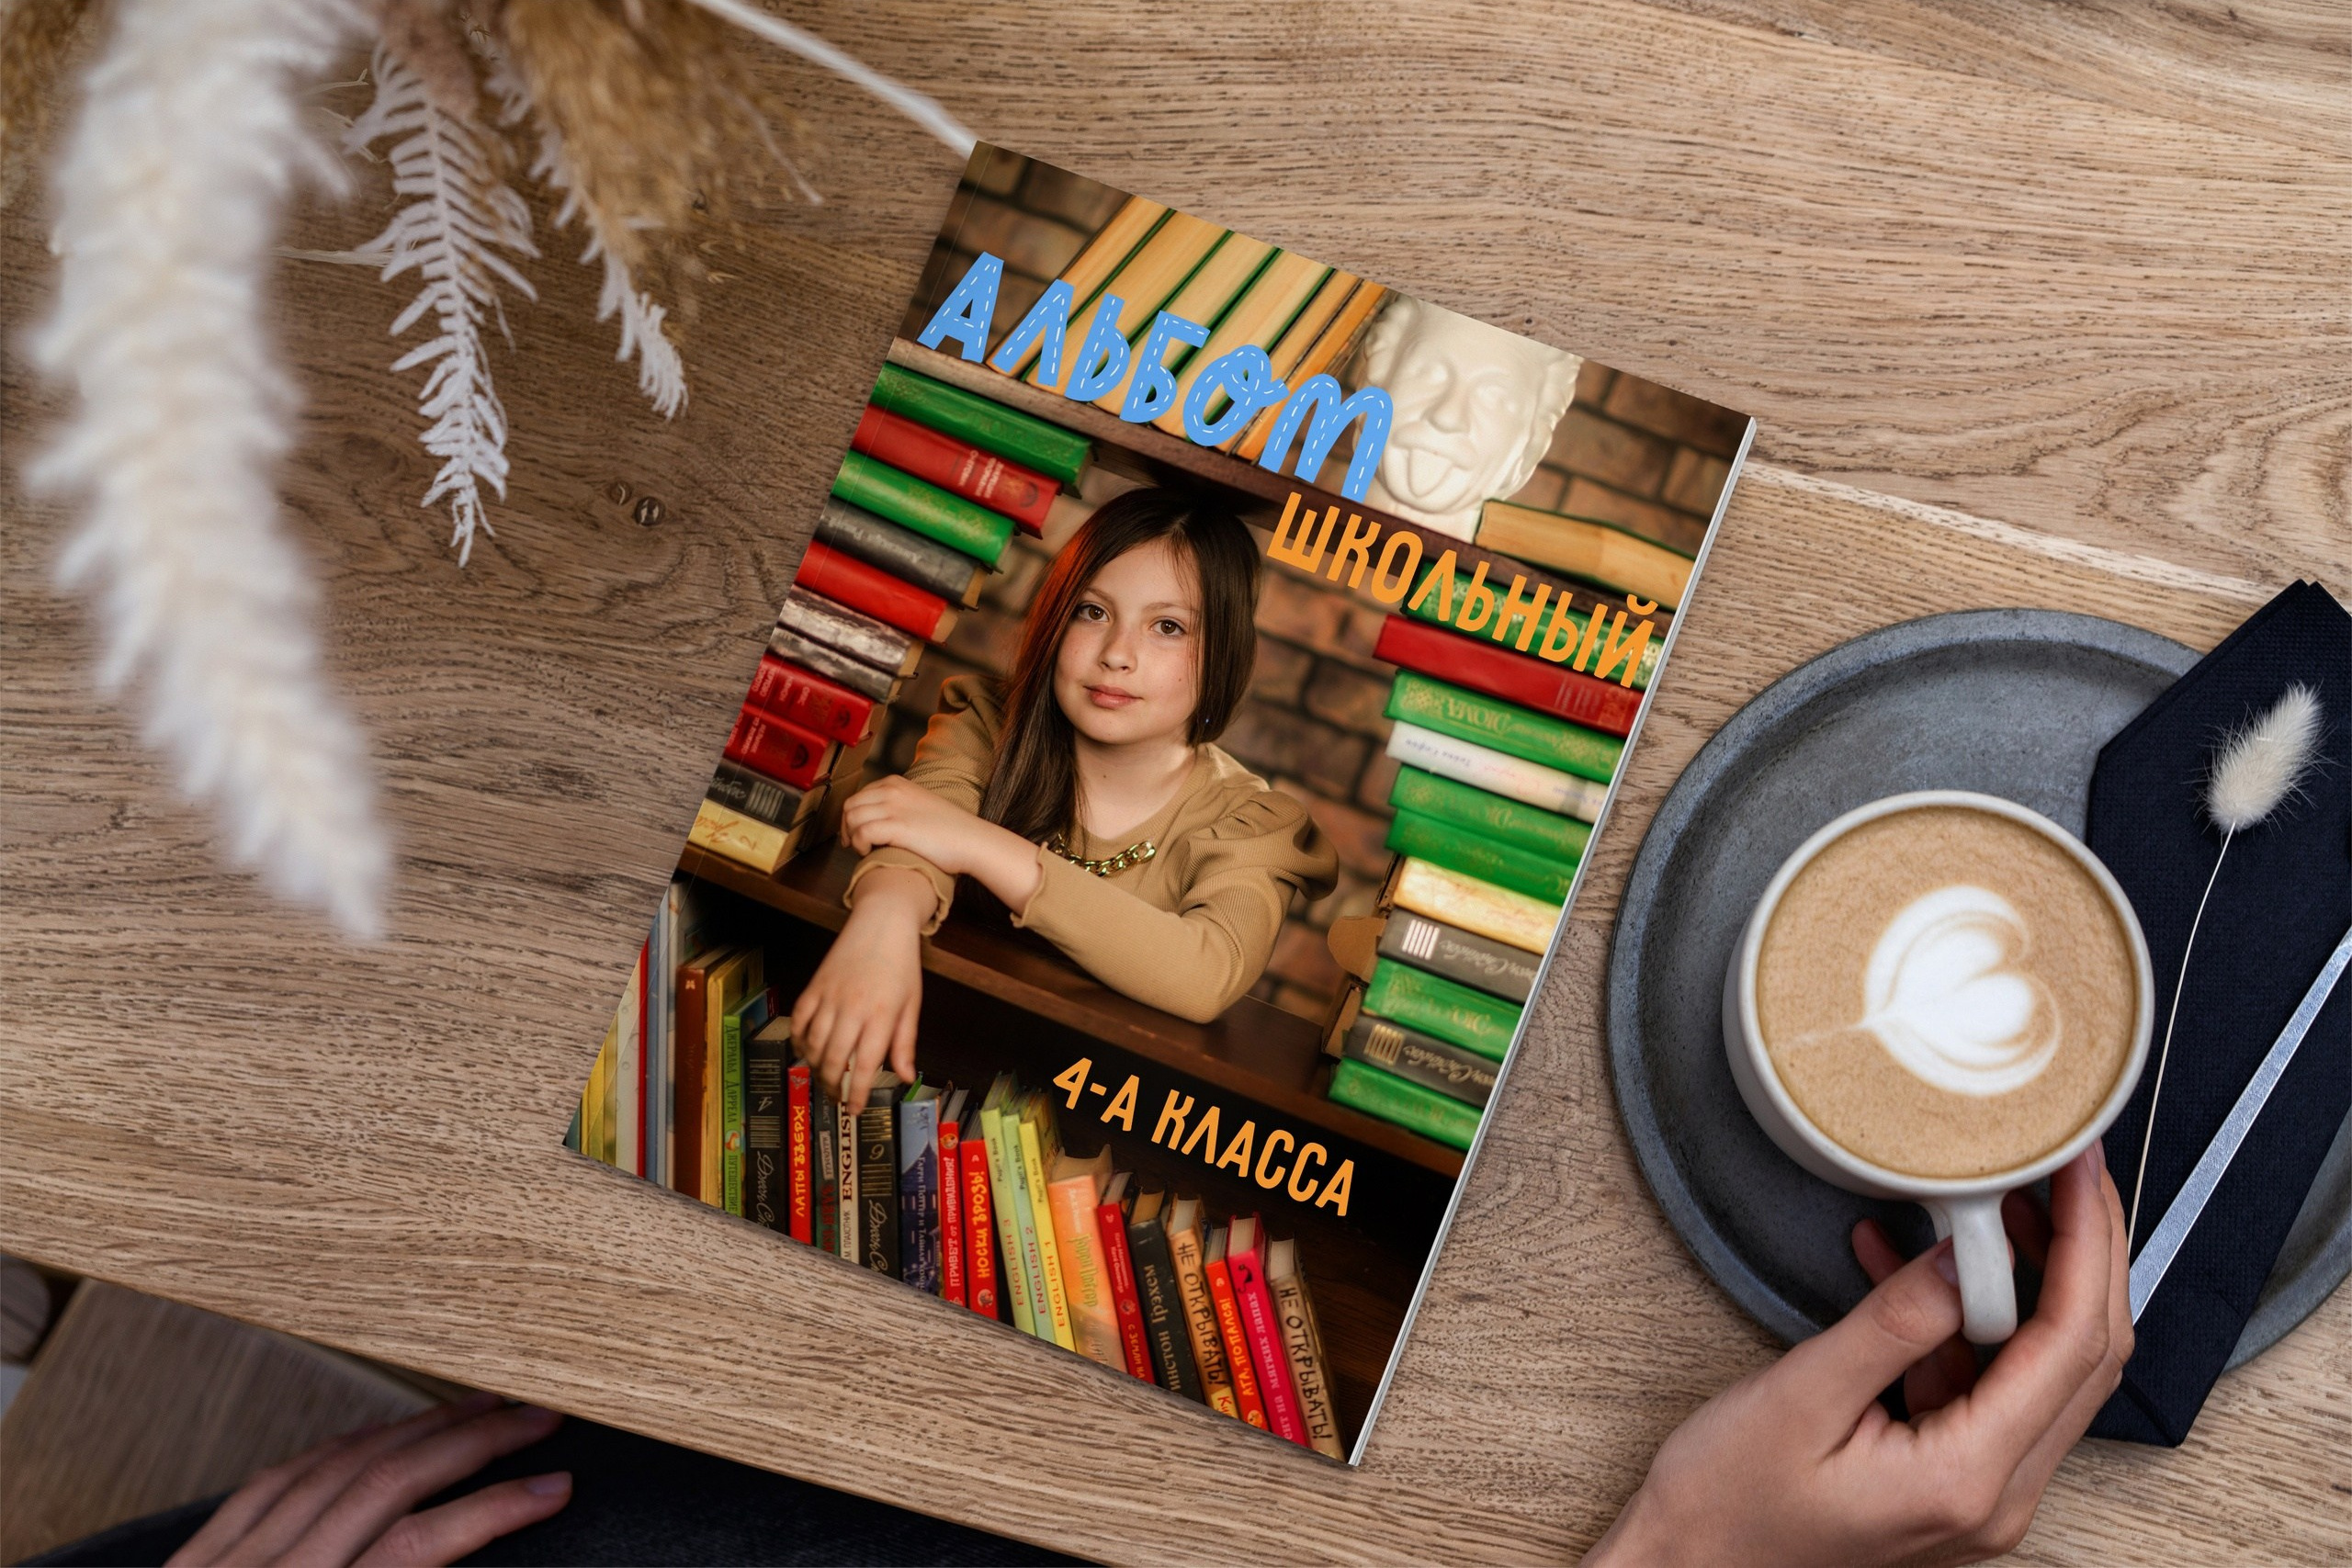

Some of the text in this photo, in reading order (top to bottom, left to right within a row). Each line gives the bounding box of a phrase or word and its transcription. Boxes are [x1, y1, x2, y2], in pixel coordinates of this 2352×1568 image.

[919, 253, 1393, 502] АЛЬБОМ
[1268, 493, 1657, 687] ШКОЛЬНЫЙ
[1053, 1057, 1139, 1131] 4-А
[1151, 1089, 1354, 1216] КЛАССА
[727, 1155, 738, 1211] ПУТЕШЕСТВИЕ
[792, 1168, 805, 1217] ЛАПЫ
[947, 1237, 961, 1287] ПРИВЕТ
[975, 1228, 989, 1278] НОСКИ
[1004, 1235, 1023, 1306] ENGLISH
[1024, 1225, 1046, 1314] ENGLISH 2
[1046, 1255, 1065, 1326] ENGLISH
[1141, 1265, 1166, 1324] Грэхем
[1178, 1244, 1227, 1385] НЕ ОТКРЫВАТЬ!
[1247, 1292, 1262, 1333] лапах
[1219, 1299, 1244, 1366] ПОПАЛСЯ!
[1260, 1337, 1279, 1388] мягких
[1279, 1286, 1330, 1438] НЕ ОТКРЫВАТЬ!
[1274, 1395, 1285, 1412] на
